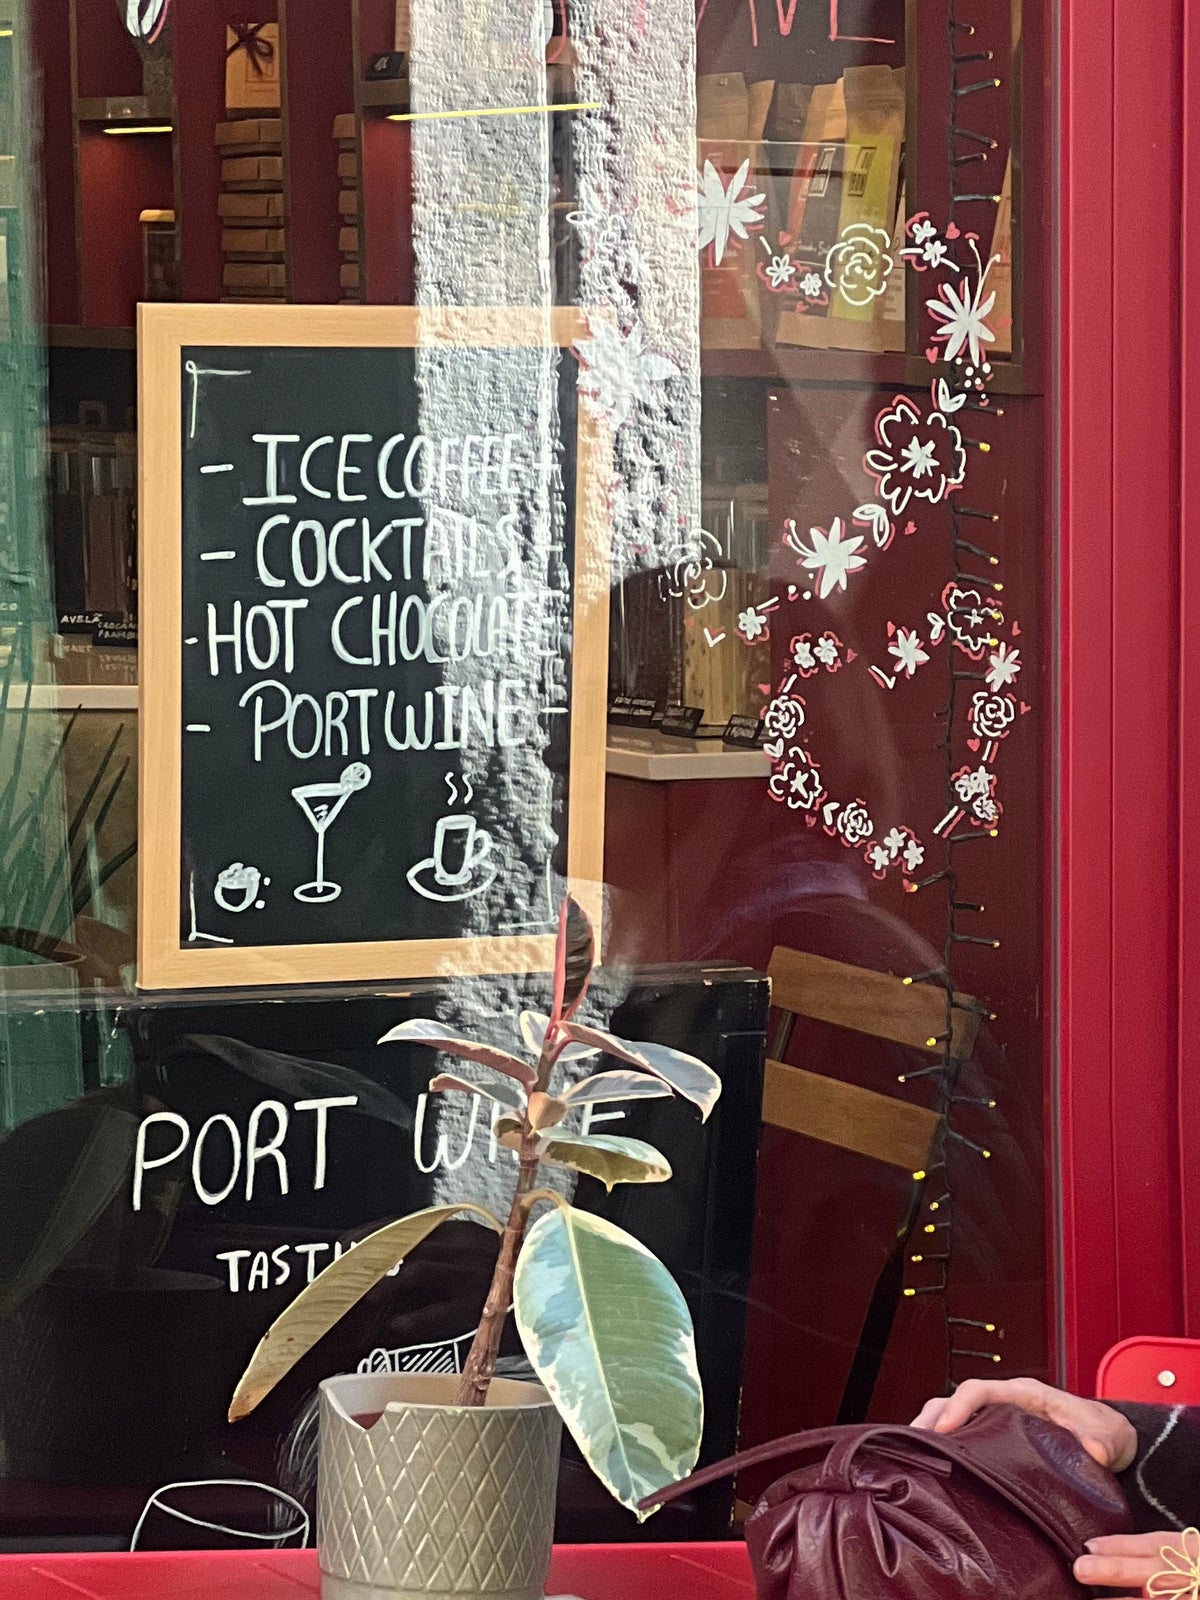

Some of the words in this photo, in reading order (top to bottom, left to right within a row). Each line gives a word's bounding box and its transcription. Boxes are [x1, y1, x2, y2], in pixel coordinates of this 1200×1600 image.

[256, 504, 521, 588] COCKTAILS
[206, 598, 309, 676] HOT
[133, 1095, 359, 1212] PORT
[414, 1081, 627, 1174] WI
[216, 1240, 404, 1293] TAST
